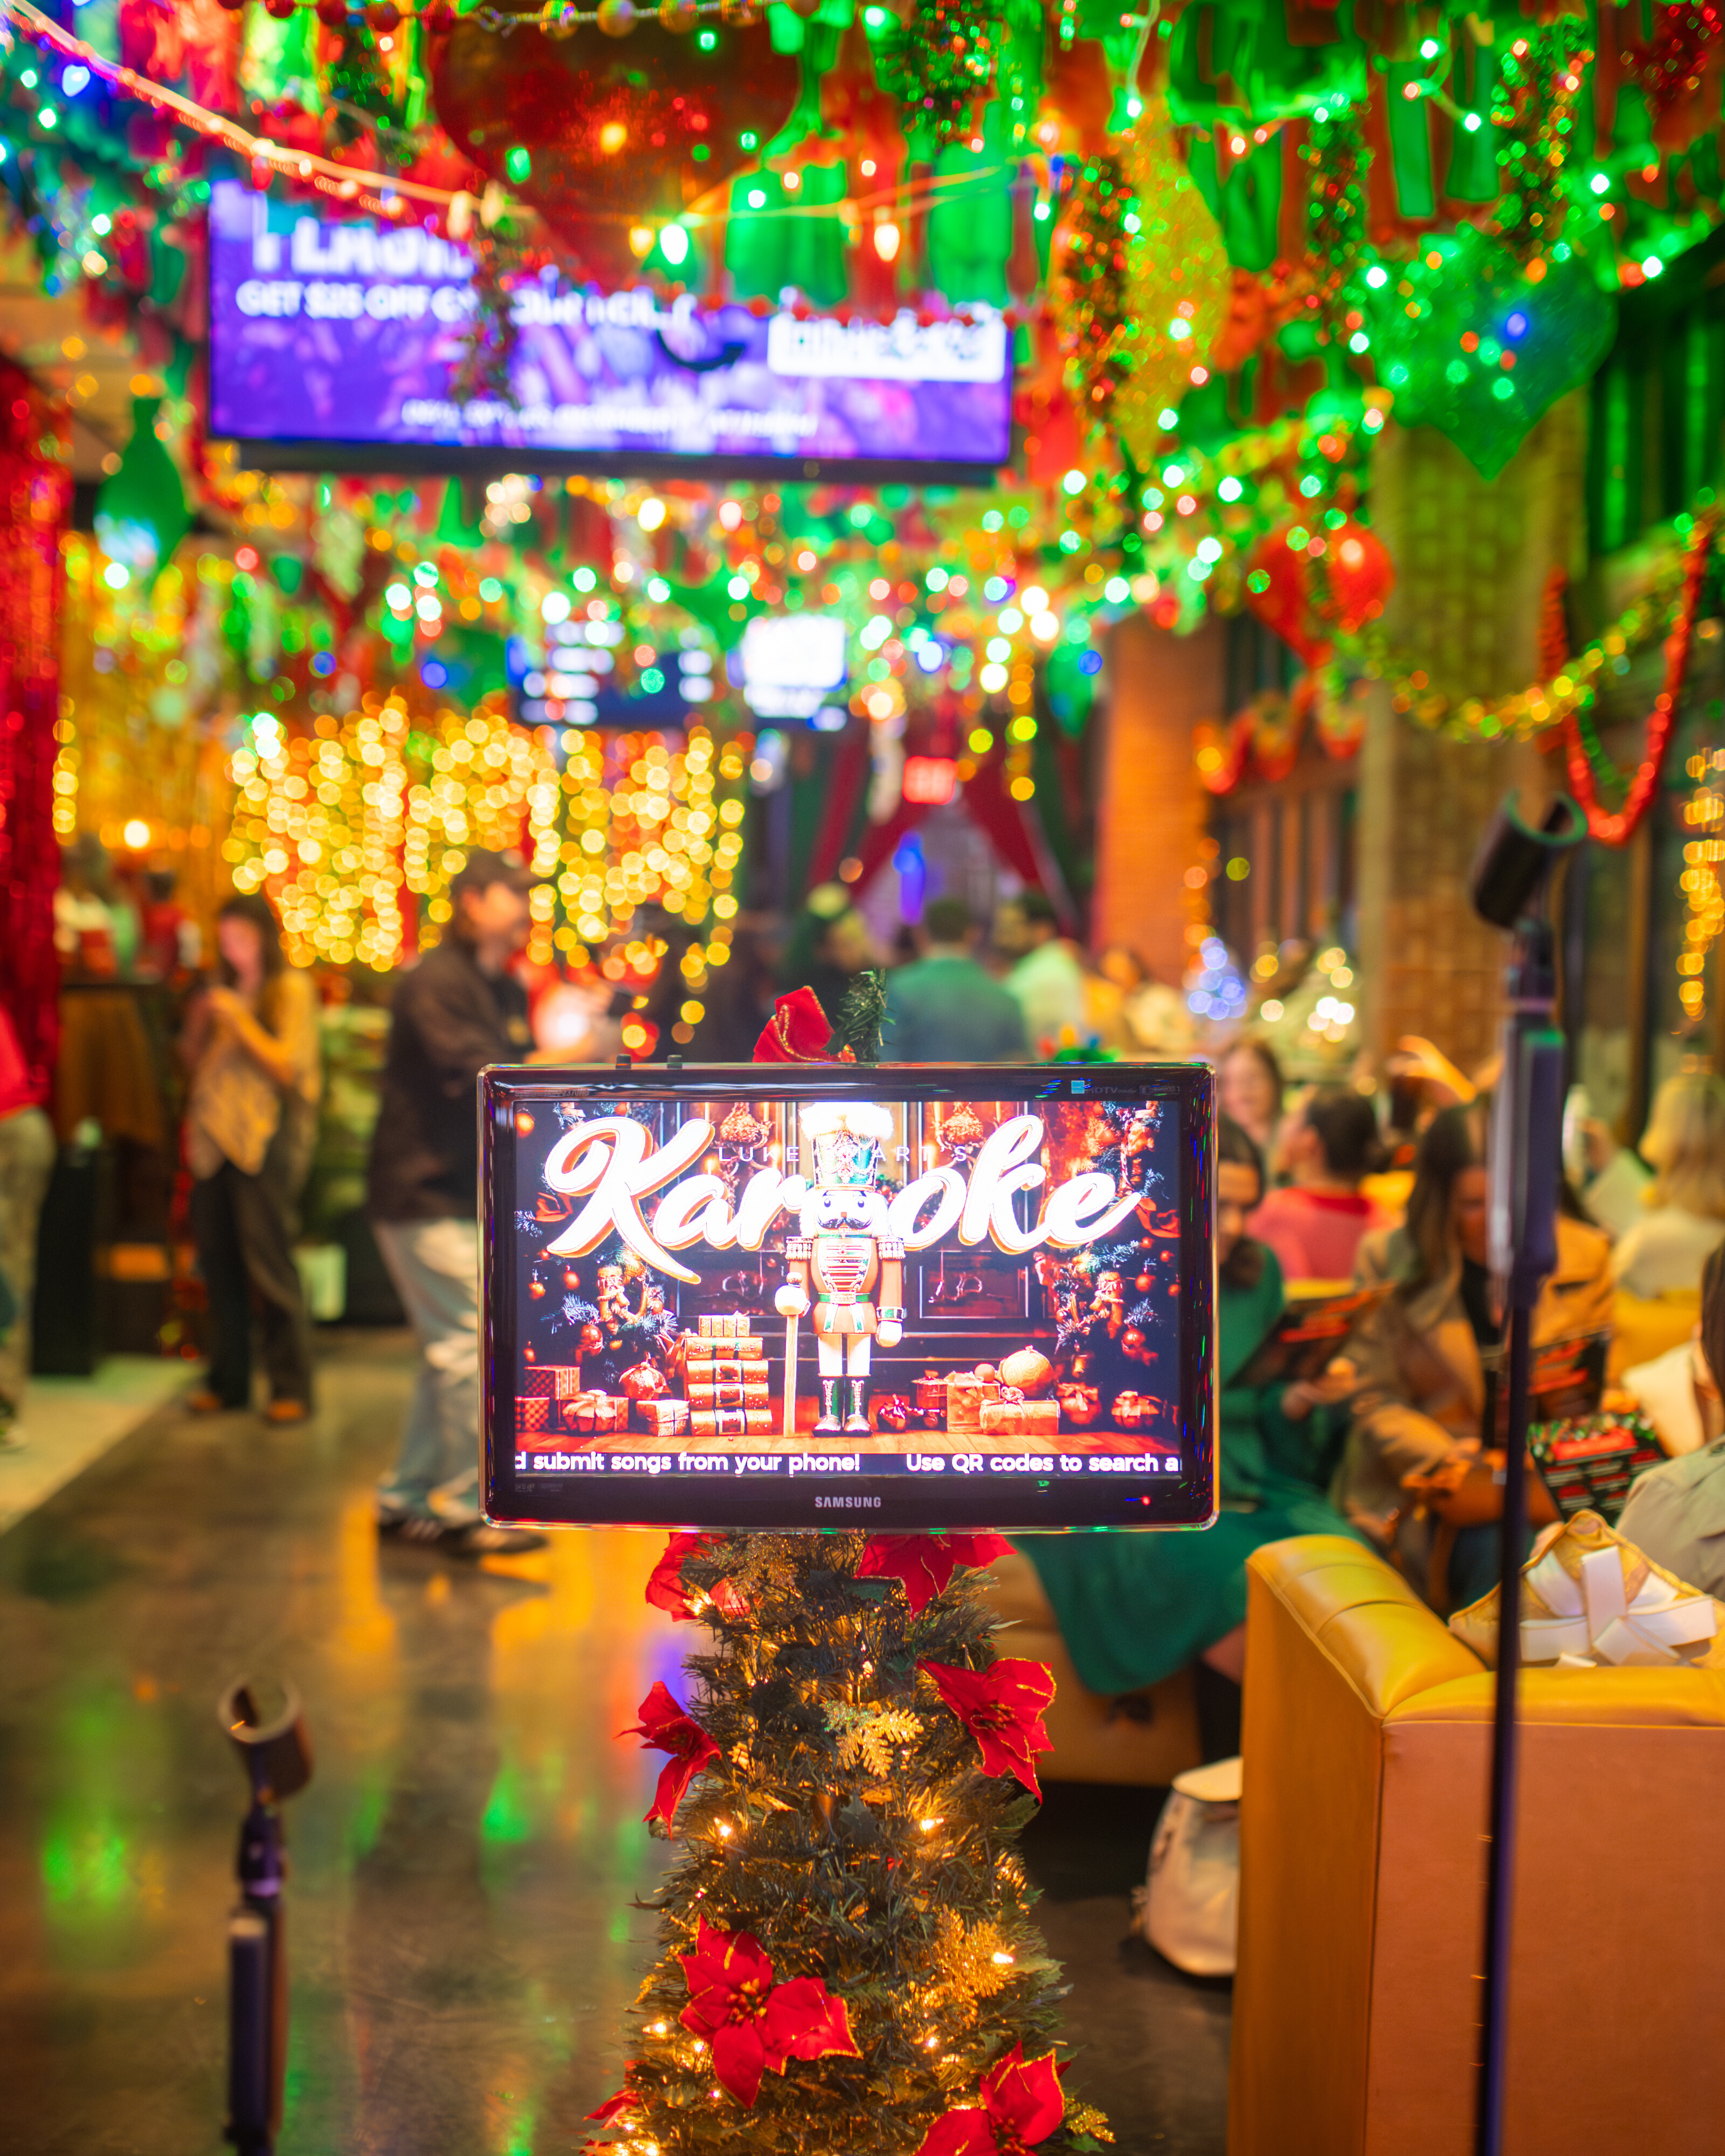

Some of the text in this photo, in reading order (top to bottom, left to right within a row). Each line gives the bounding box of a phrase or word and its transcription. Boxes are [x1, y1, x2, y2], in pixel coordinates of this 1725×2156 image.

[718, 1145, 799, 1162] LUKE
[547, 1114, 1141, 1284] Karoke
[533, 1451, 604, 1470] submit
[611, 1456, 672, 1474] songs
[678, 1450, 728, 1470] from
[734, 1456, 782, 1475] your
[789, 1452, 860, 1475] phone!
[906, 1454, 946, 1471] Use
[951, 1454, 984, 1474] QR
[990, 1453, 1054, 1471] codes
[1059, 1454, 1082, 1471] to
[1088, 1453, 1158, 1471] search
[1165, 1457, 1182, 1471] a
[815, 1496, 881, 1508] SAMSUNG
